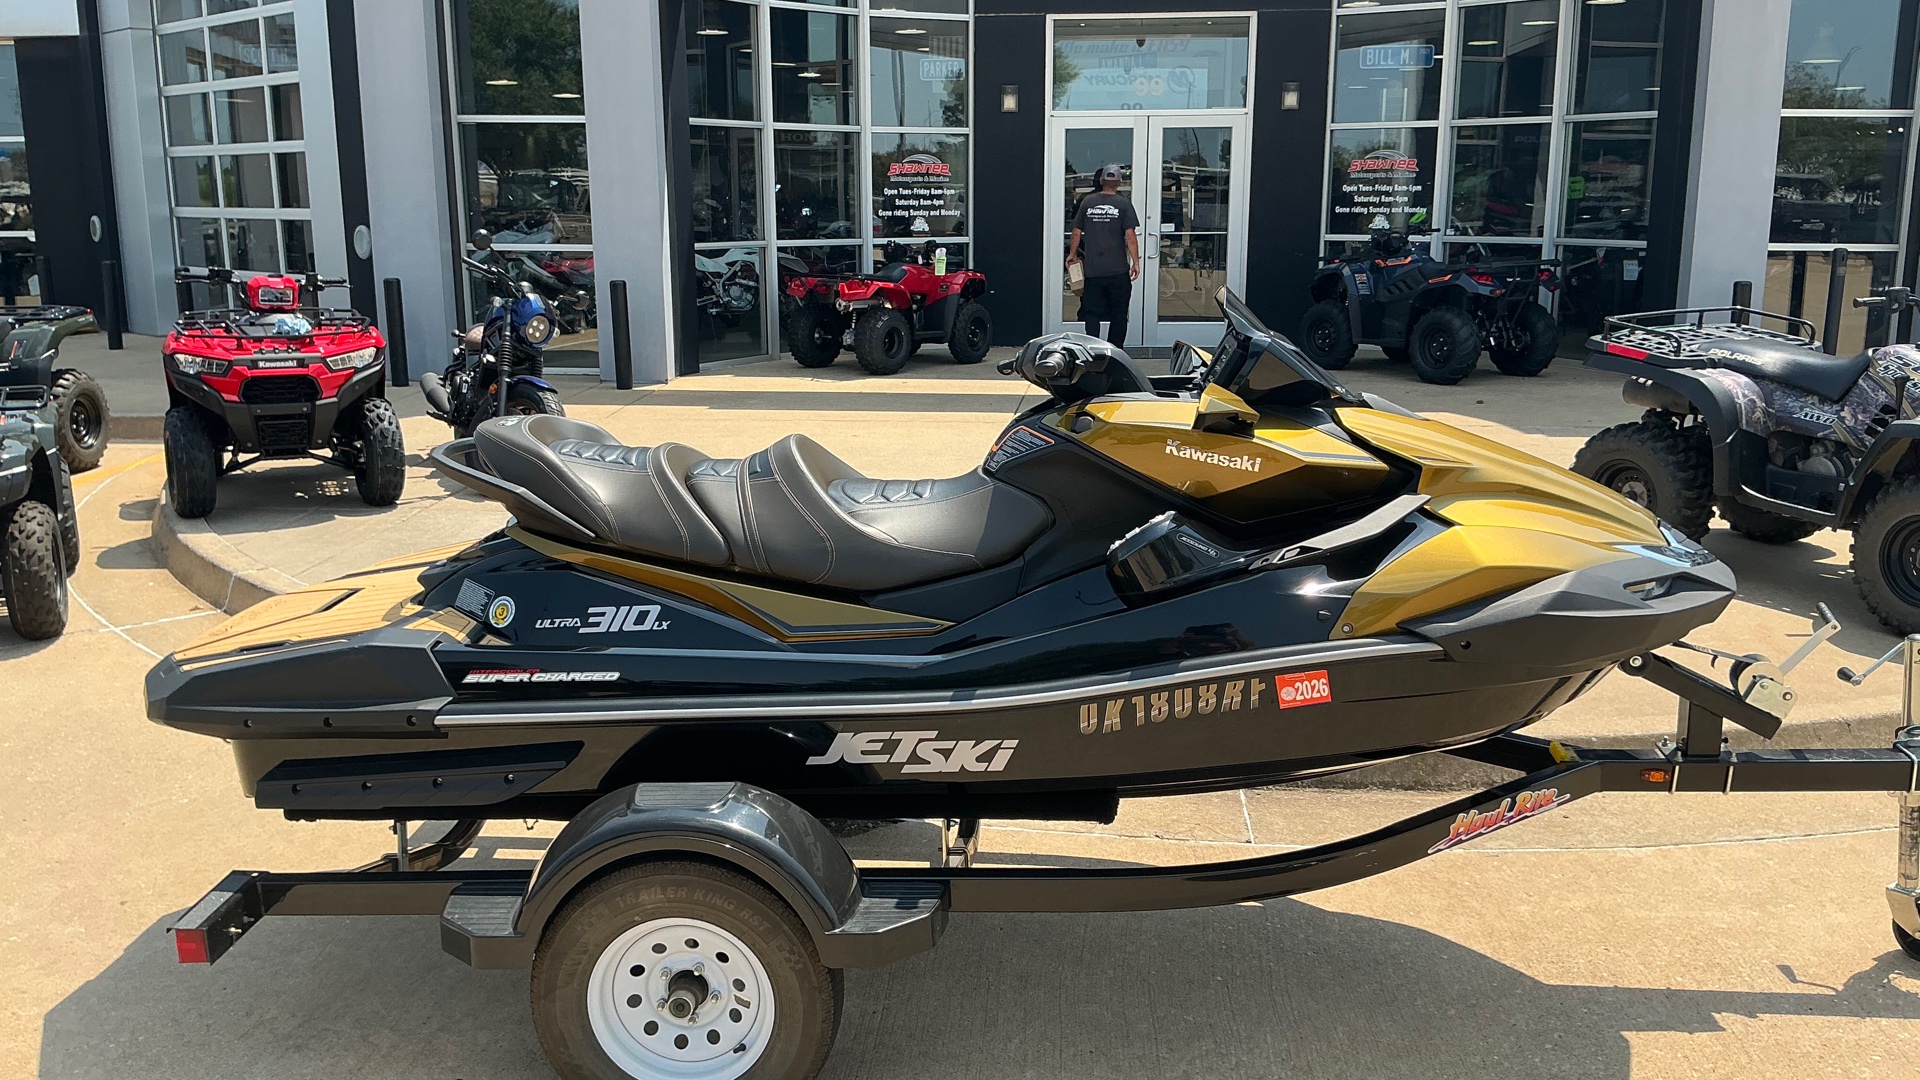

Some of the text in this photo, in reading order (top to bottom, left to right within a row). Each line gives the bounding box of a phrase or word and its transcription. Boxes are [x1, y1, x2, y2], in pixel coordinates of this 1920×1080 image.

[243, 47, 277, 62] SCT
[1366, 49, 1414, 65] BILL M.
[923, 61, 960, 77] PARKER
[883, 188, 898, 196] Open
[1342, 185, 1357, 193] Open
[1354, 195, 1380, 203] Saturday
[878, 209, 893, 217] Gone
[893, 209, 909, 217] riding
[910, 209, 929, 217] Sunday
[940, 209, 961, 217] Monday
[1351, 206, 1368, 214] riding
[1369, 206, 1390, 214] Sunday
[1403, 206, 1427, 214] Monday
[258, 360, 297, 368] Kawasaki
[1709, 347, 1764, 366] POLARIS
[1164, 438, 1262, 473] Kawasaki
[498, 607, 506, 617] 3
[535, 604, 672, 634] ULTRA 310 LX
[1294, 677, 1329, 701] 2026
[1449, 798, 1511, 840] Haul
[615, 885, 687, 909] TRAILER
[692, 884, 735, 913] KING
